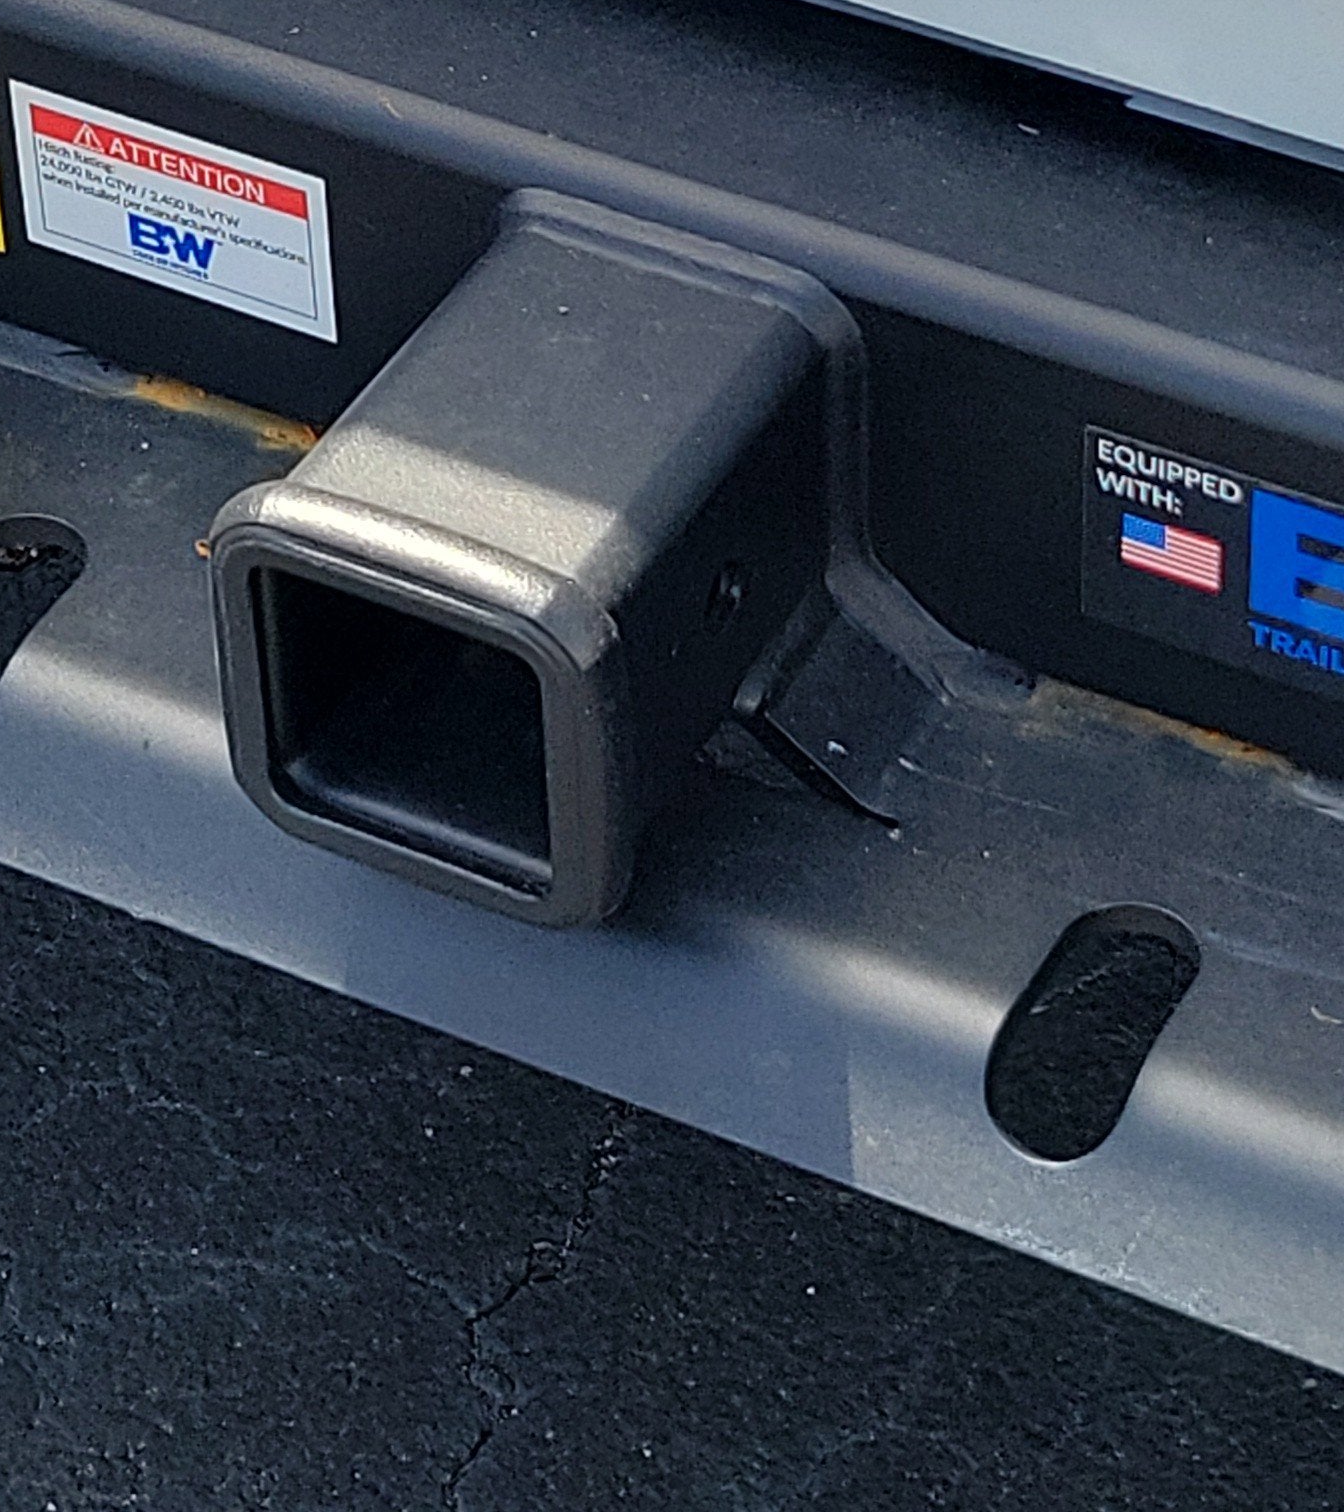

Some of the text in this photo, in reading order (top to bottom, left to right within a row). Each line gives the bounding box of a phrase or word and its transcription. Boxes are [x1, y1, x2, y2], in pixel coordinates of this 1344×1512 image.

[109, 137, 265, 204] ATTENTION
[106, 177, 137, 195] GTW
[208, 210, 239, 228] VTW
[1096, 467, 1183, 516] WITH:
[1097, 439, 1243, 504] EQUIPPED
